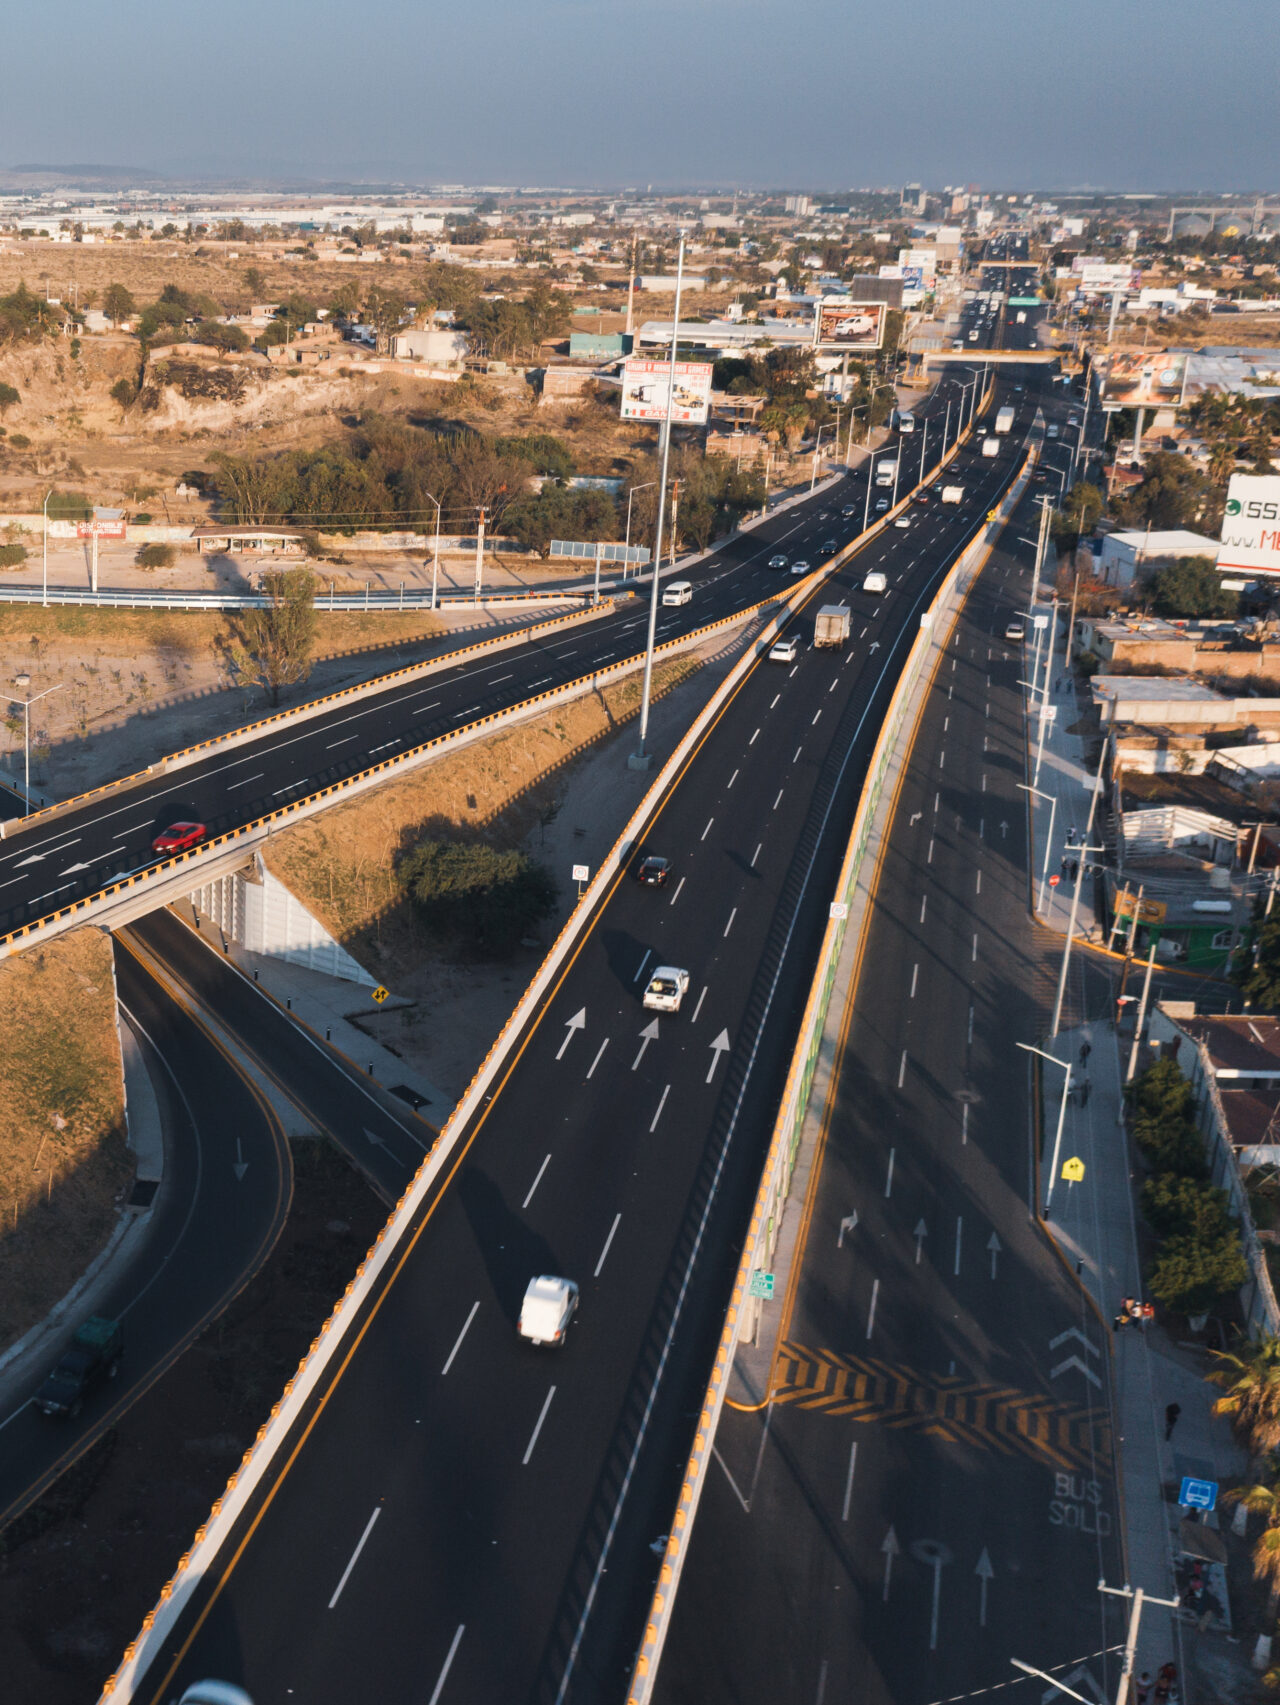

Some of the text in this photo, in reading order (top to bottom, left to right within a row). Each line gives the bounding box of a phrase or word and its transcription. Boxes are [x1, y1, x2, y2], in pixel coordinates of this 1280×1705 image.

[647, 362, 652, 371] Y
[1055, 1472, 1102, 1504] BUS
[1048, 1500, 1111, 1536] SOLO
